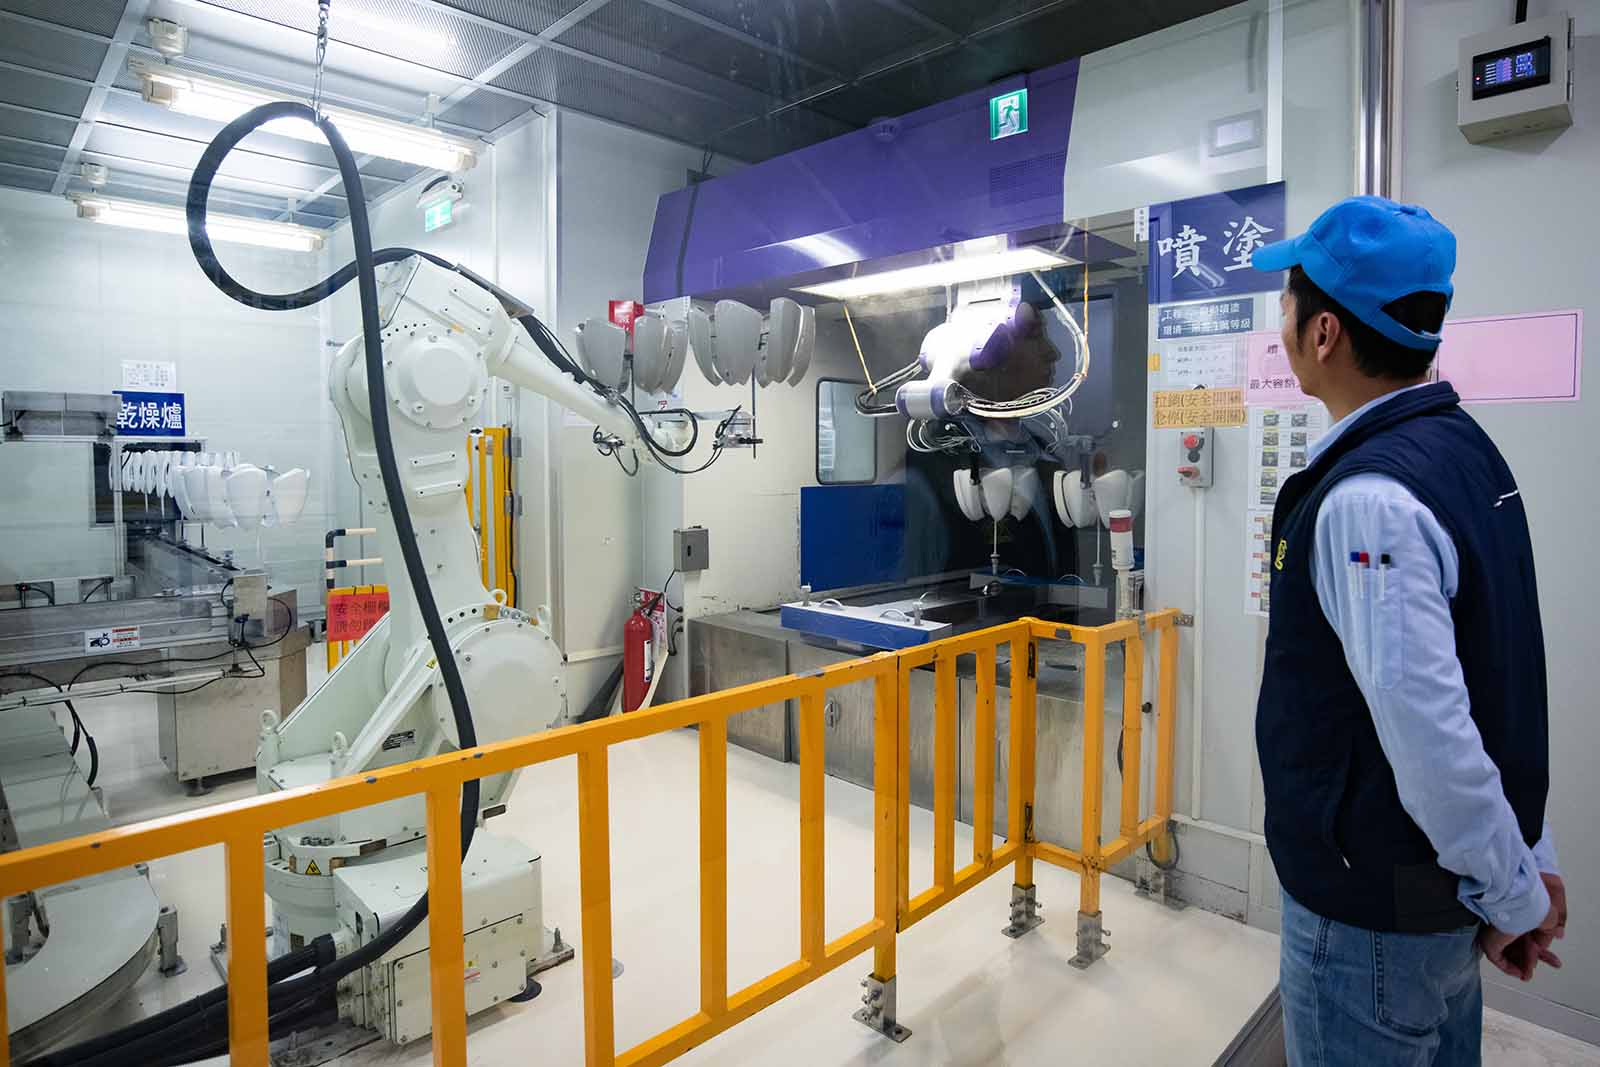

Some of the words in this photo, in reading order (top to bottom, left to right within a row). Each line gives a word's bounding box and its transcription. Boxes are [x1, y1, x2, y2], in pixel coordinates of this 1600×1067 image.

[1157, 216, 1275, 279] 噴塗
[116, 401, 183, 429] 乾燥爐
